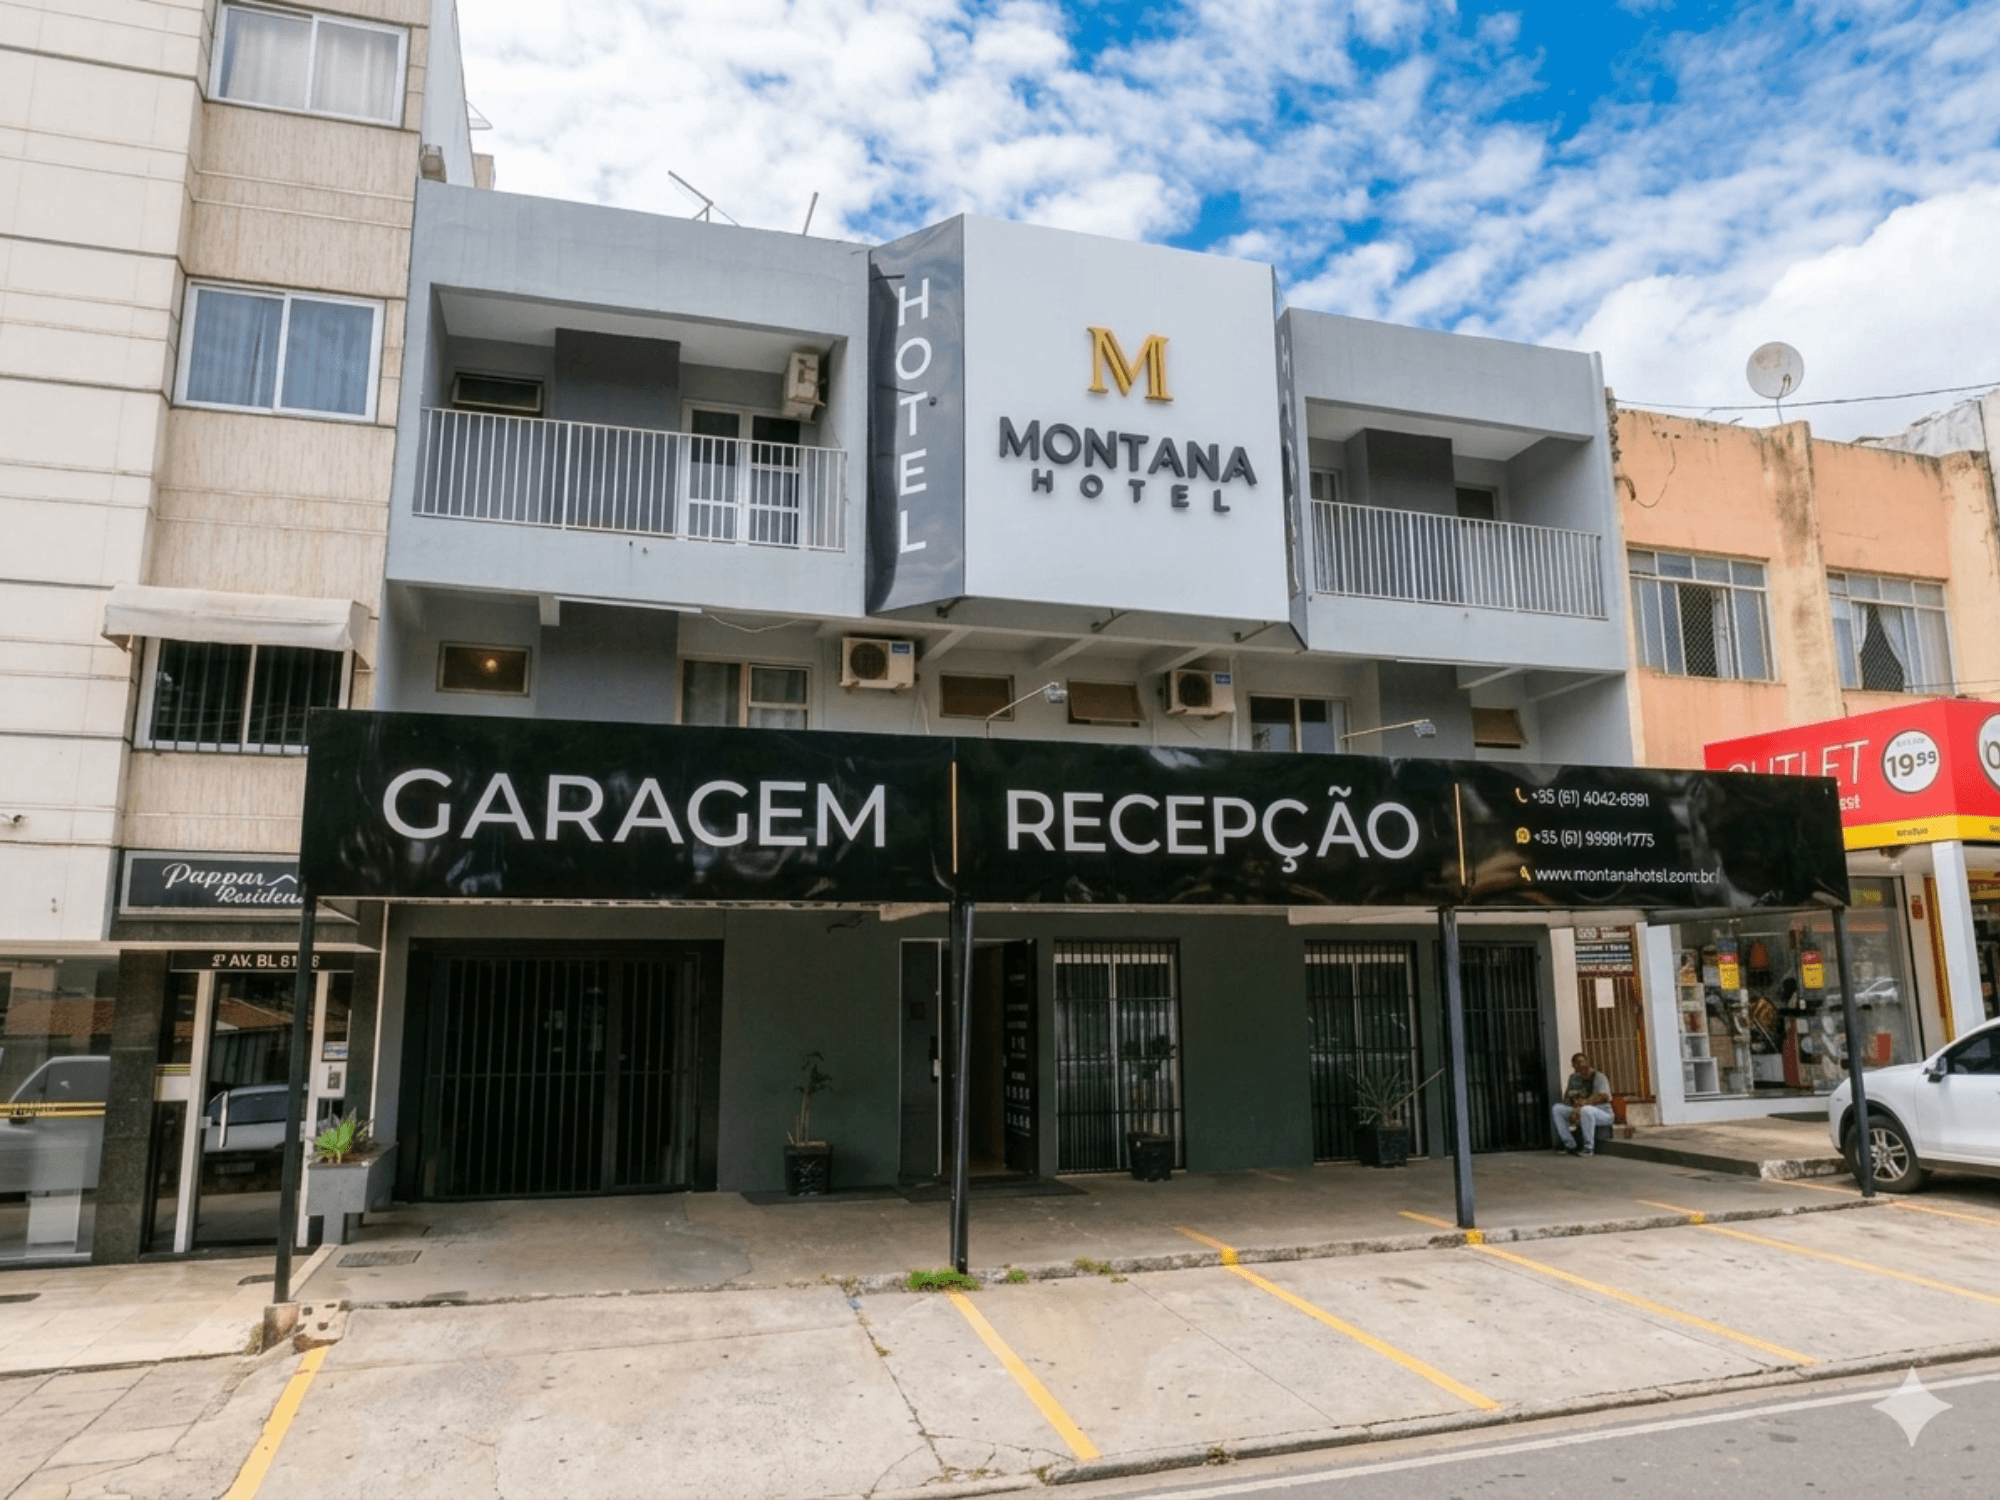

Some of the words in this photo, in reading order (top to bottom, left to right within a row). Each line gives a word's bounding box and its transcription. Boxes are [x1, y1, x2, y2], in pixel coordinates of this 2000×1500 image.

[1086, 326, 1174, 402] M
[895, 277, 932, 554] HOTEL
[999, 416, 1258, 486] MONTANA
[1031, 468, 1231, 512] HOTEL
[383, 768, 886, 848] GARAGEM
[1006, 786, 1420, 873] RECEPÇÃO
[1560, 829, 1582, 849] (61)
[256, 953, 277, 968] BL
